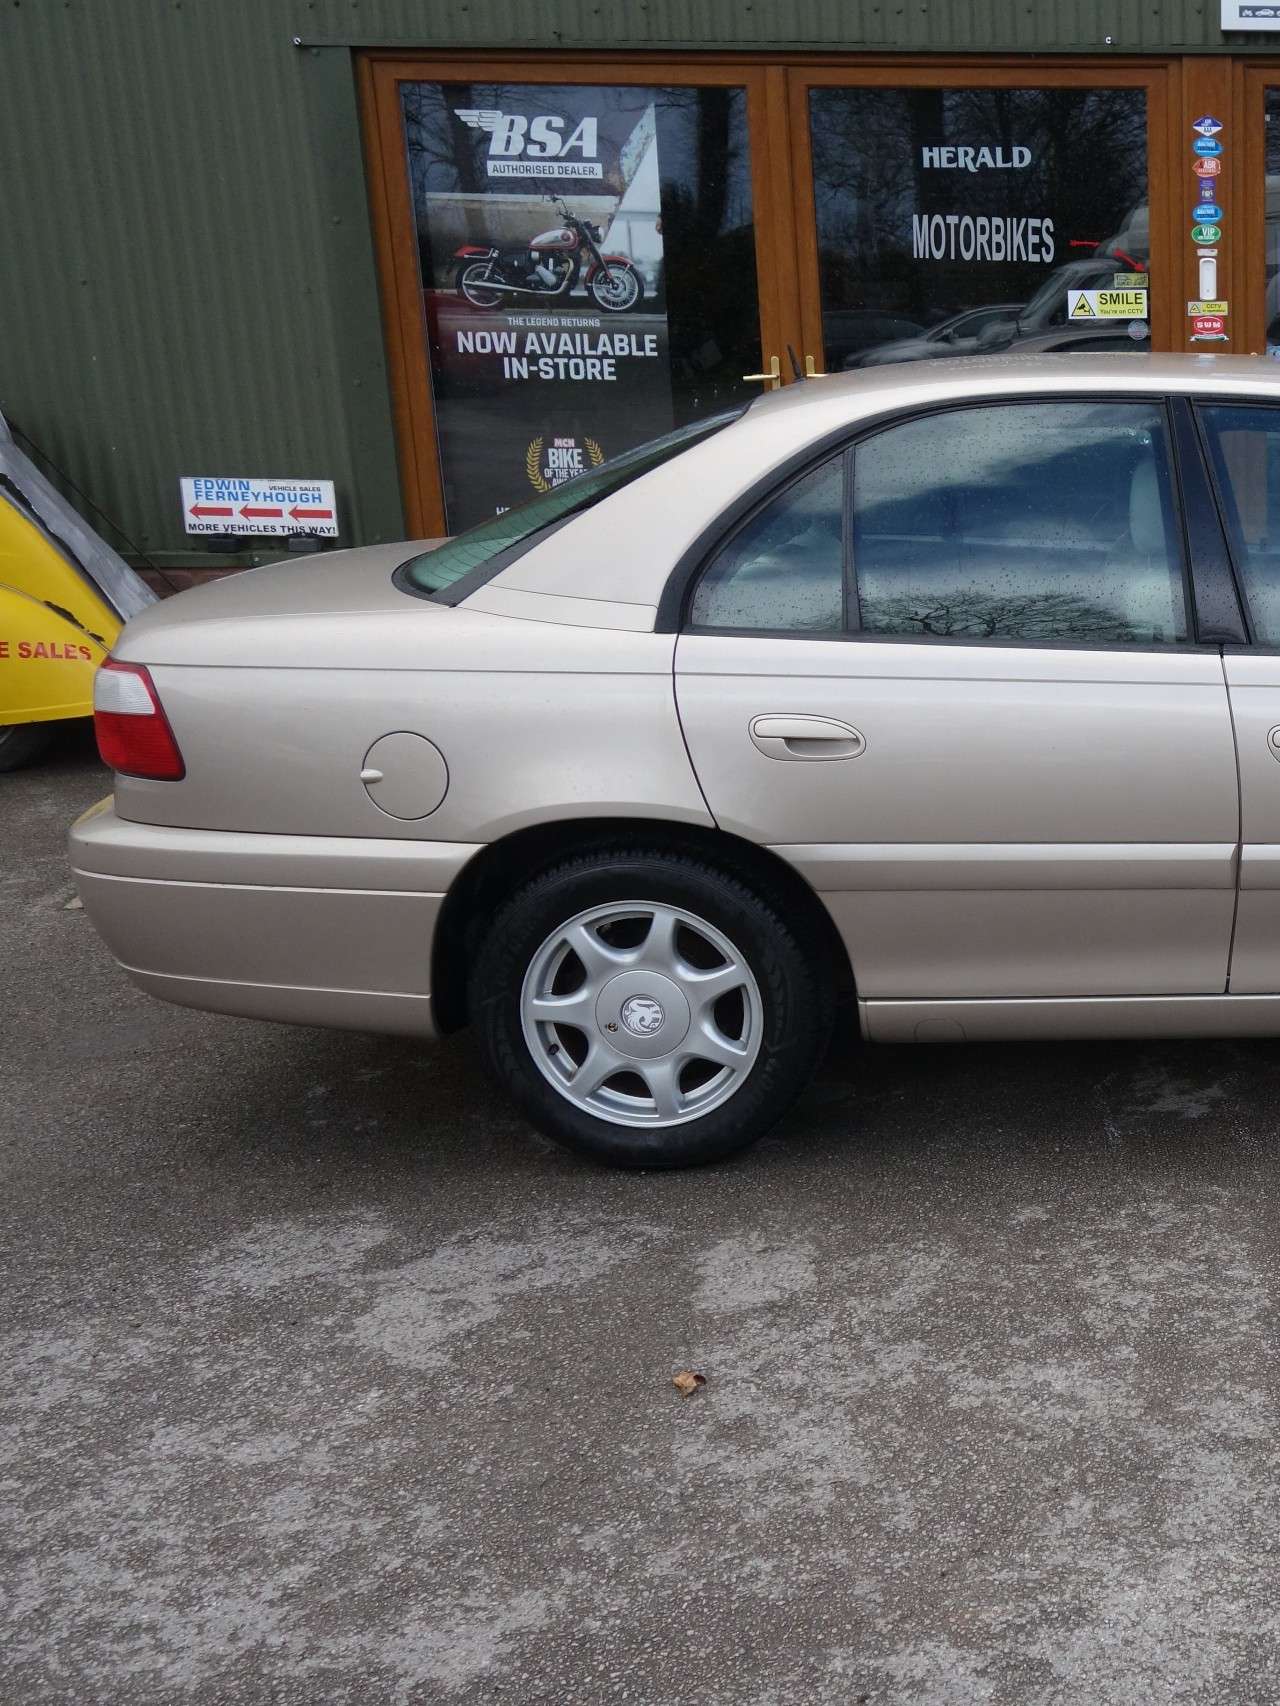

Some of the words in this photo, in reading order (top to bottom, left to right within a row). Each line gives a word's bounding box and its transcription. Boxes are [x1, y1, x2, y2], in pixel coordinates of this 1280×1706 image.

[489, 115, 598, 157] BSA
[922, 146, 1032, 172] HERALD
[492, 164, 555, 175] AUTHORISED
[912, 213, 1055, 263] MOTORBIKES
[1099, 293, 1143, 305] SMILE
[508, 317, 525, 326] THE
[526, 318, 559, 327] LEGEND
[561, 319, 600, 328] RETURNS
[457, 331, 517, 354] NOW
[524, 332, 658, 357] AVAILABLE
[503, 356, 617, 381] IN-STORE
[548, 448, 584, 468] BIKE
[544, 468, 556, 478] OF
[556, 468, 569, 478] THE
[194, 479, 250, 490] EDWIN
[195, 490, 322, 503] FERNEYHOUGH
[188, 523, 220, 532] MORE
[222, 524, 277, 533] VEHICLES
[280, 525, 306, 534] THIS
[309, 526, 336, 535] WAY!
[18, 642, 92, 660] SALES
